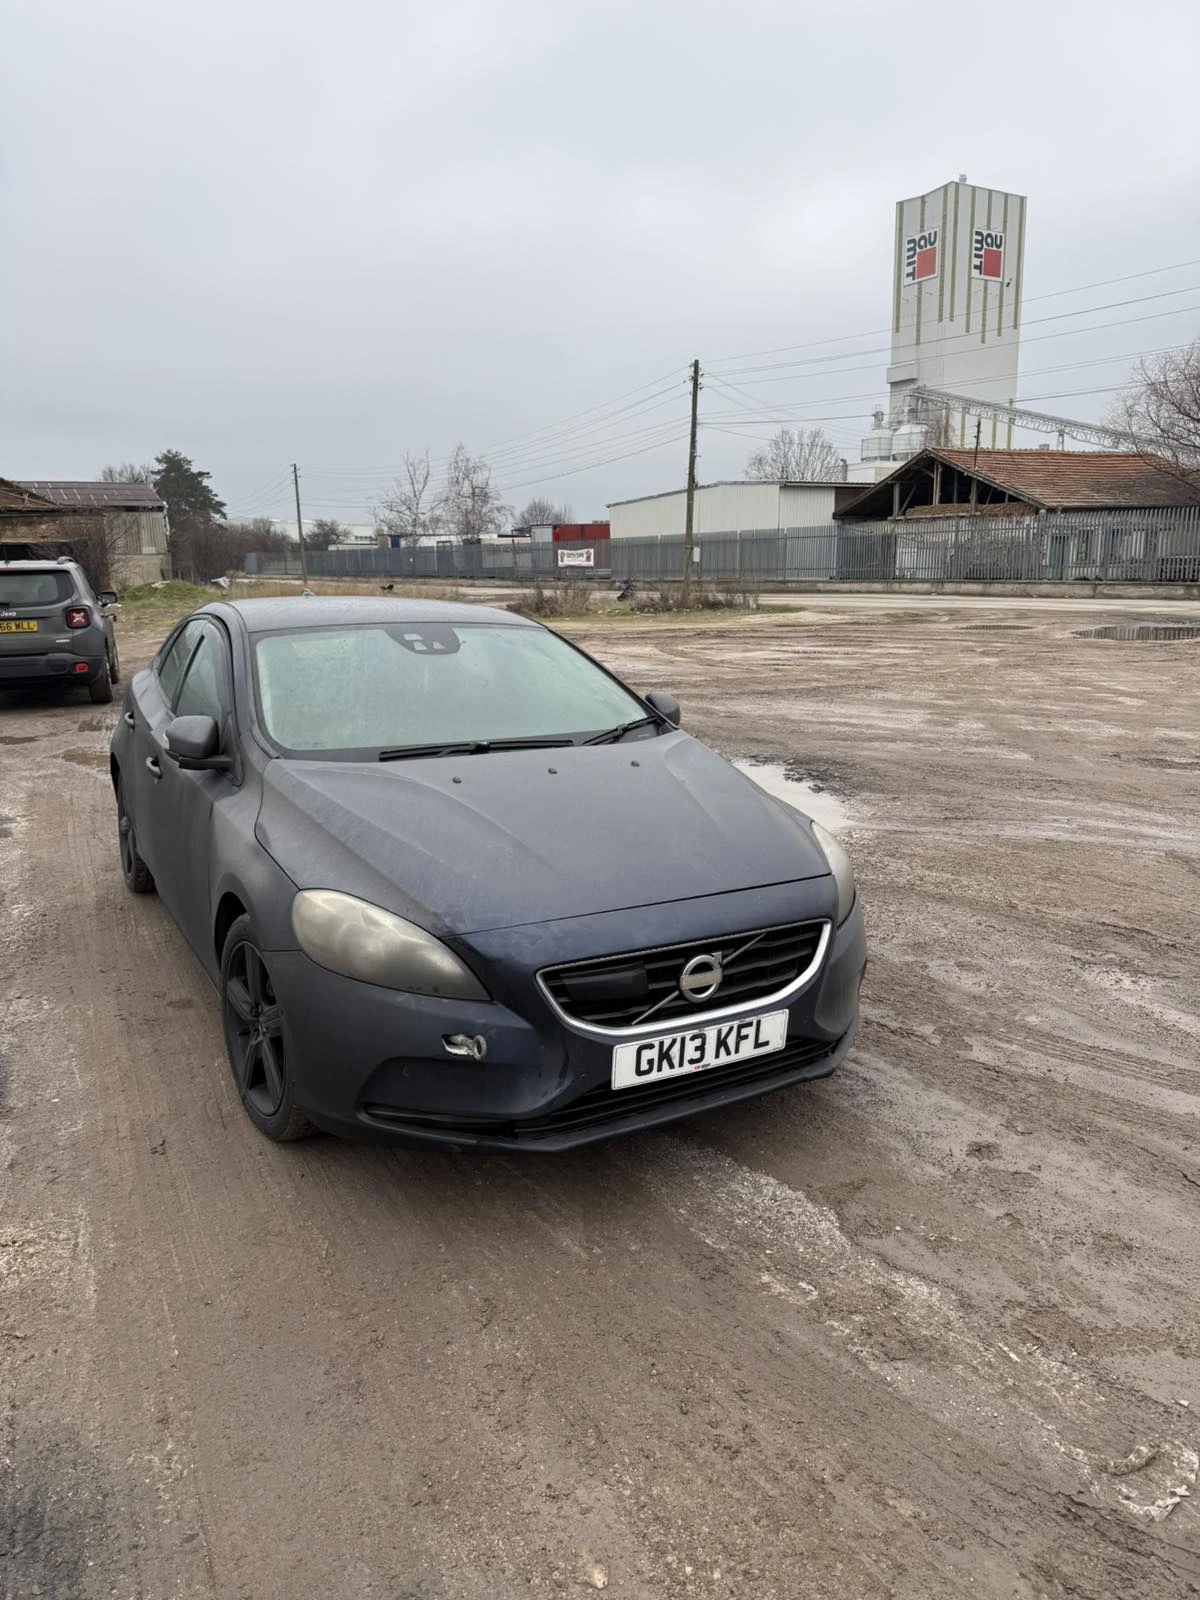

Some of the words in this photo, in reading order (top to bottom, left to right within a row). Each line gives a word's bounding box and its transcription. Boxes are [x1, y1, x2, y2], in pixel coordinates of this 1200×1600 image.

[15, 621, 35, 630] WLL
[635, 1032, 707, 1077] GK13
[714, 1019, 770, 1060] KFL
